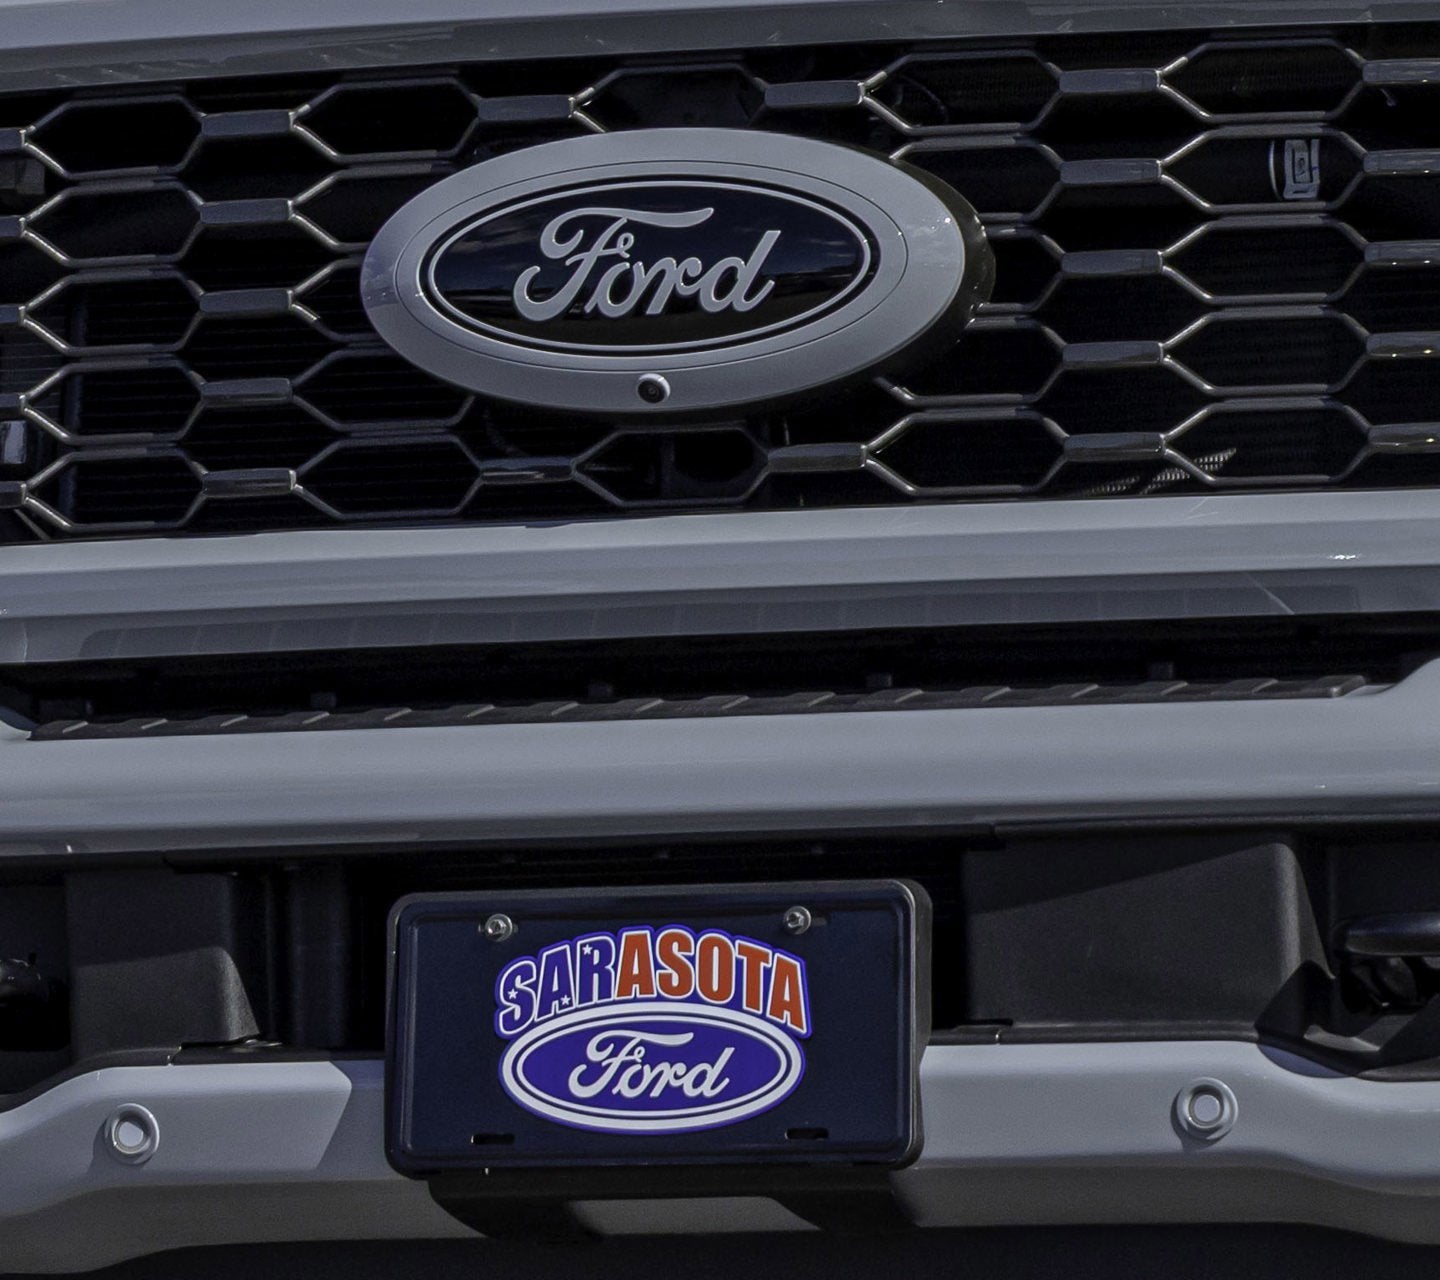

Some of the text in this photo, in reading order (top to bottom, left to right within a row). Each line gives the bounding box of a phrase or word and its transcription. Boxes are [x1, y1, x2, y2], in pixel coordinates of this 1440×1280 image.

[513, 206, 781, 324] Ford
[496, 925, 811, 1037] SARASOTA
[568, 1028, 736, 1099] Ford
